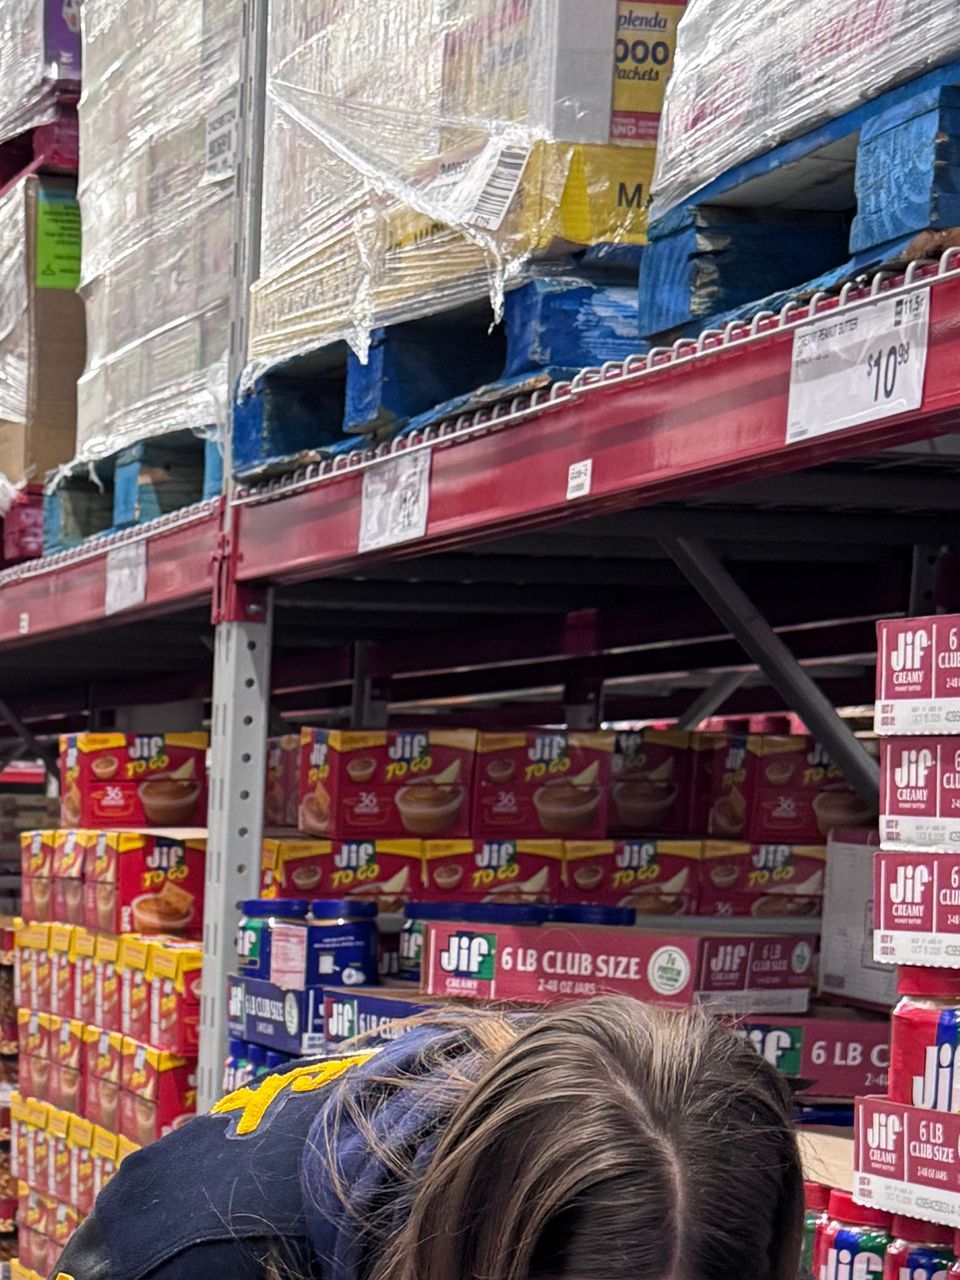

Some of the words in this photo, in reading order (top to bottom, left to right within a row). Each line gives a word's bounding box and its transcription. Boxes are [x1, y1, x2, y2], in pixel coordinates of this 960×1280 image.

[891, 629, 929, 671] Jif
[949, 628, 957, 650] 6
[893, 671, 924, 684] CREAMY
[128, 736, 163, 759] Jif
[388, 733, 427, 760] Jif
[528, 735, 567, 761] Jif
[386, 762, 407, 779] TO
[410, 756, 432, 772] GO
[525, 763, 546, 781] TO
[548, 757, 570, 773] GO
[895, 749, 933, 788] Jif
[106, 786, 122, 801] 36
[358, 792, 377, 806] 36
[497, 792, 516, 806] 36
[897, 788, 928, 801] CREAMY
[145, 846, 183, 868] Jif
[334, 844, 374, 867] Jif
[475, 844, 514, 867] Jif
[615, 844, 656, 868] Jif
[752, 845, 792, 868] Jif
[332, 870, 353, 888] TO
[356, 864, 380, 880] GO
[472, 870, 494, 887] TO
[497, 863, 520, 879] GO
[613, 870, 635, 887] TO
[638, 864, 660, 880] GO
[889, 865, 929, 903] Jif
[951, 866, 959, 888] 6
[892, 904, 925, 917] CREAMY
[440, 936, 491, 973] Jif
[501, 948, 512, 970] 6
[516, 949, 538, 973] LB
[542, 951, 593, 977] CLUB
[596, 955, 640, 980] SIZE
[710, 945, 746, 972] Jif
[328, 1003, 353, 1037] Jif
[812, 1042, 827, 1065] 6
[835, 1042, 863, 1067] LB
[867, 1112, 901, 1151] Jif
[919, 1120, 927, 1142] 6
[930, 1123, 944, 1145] LB
[869, 1149, 897, 1165] CREAMY
[910, 1141, 933, 1160] CLUB
[933, 1143, 955, 1163] SIZE
